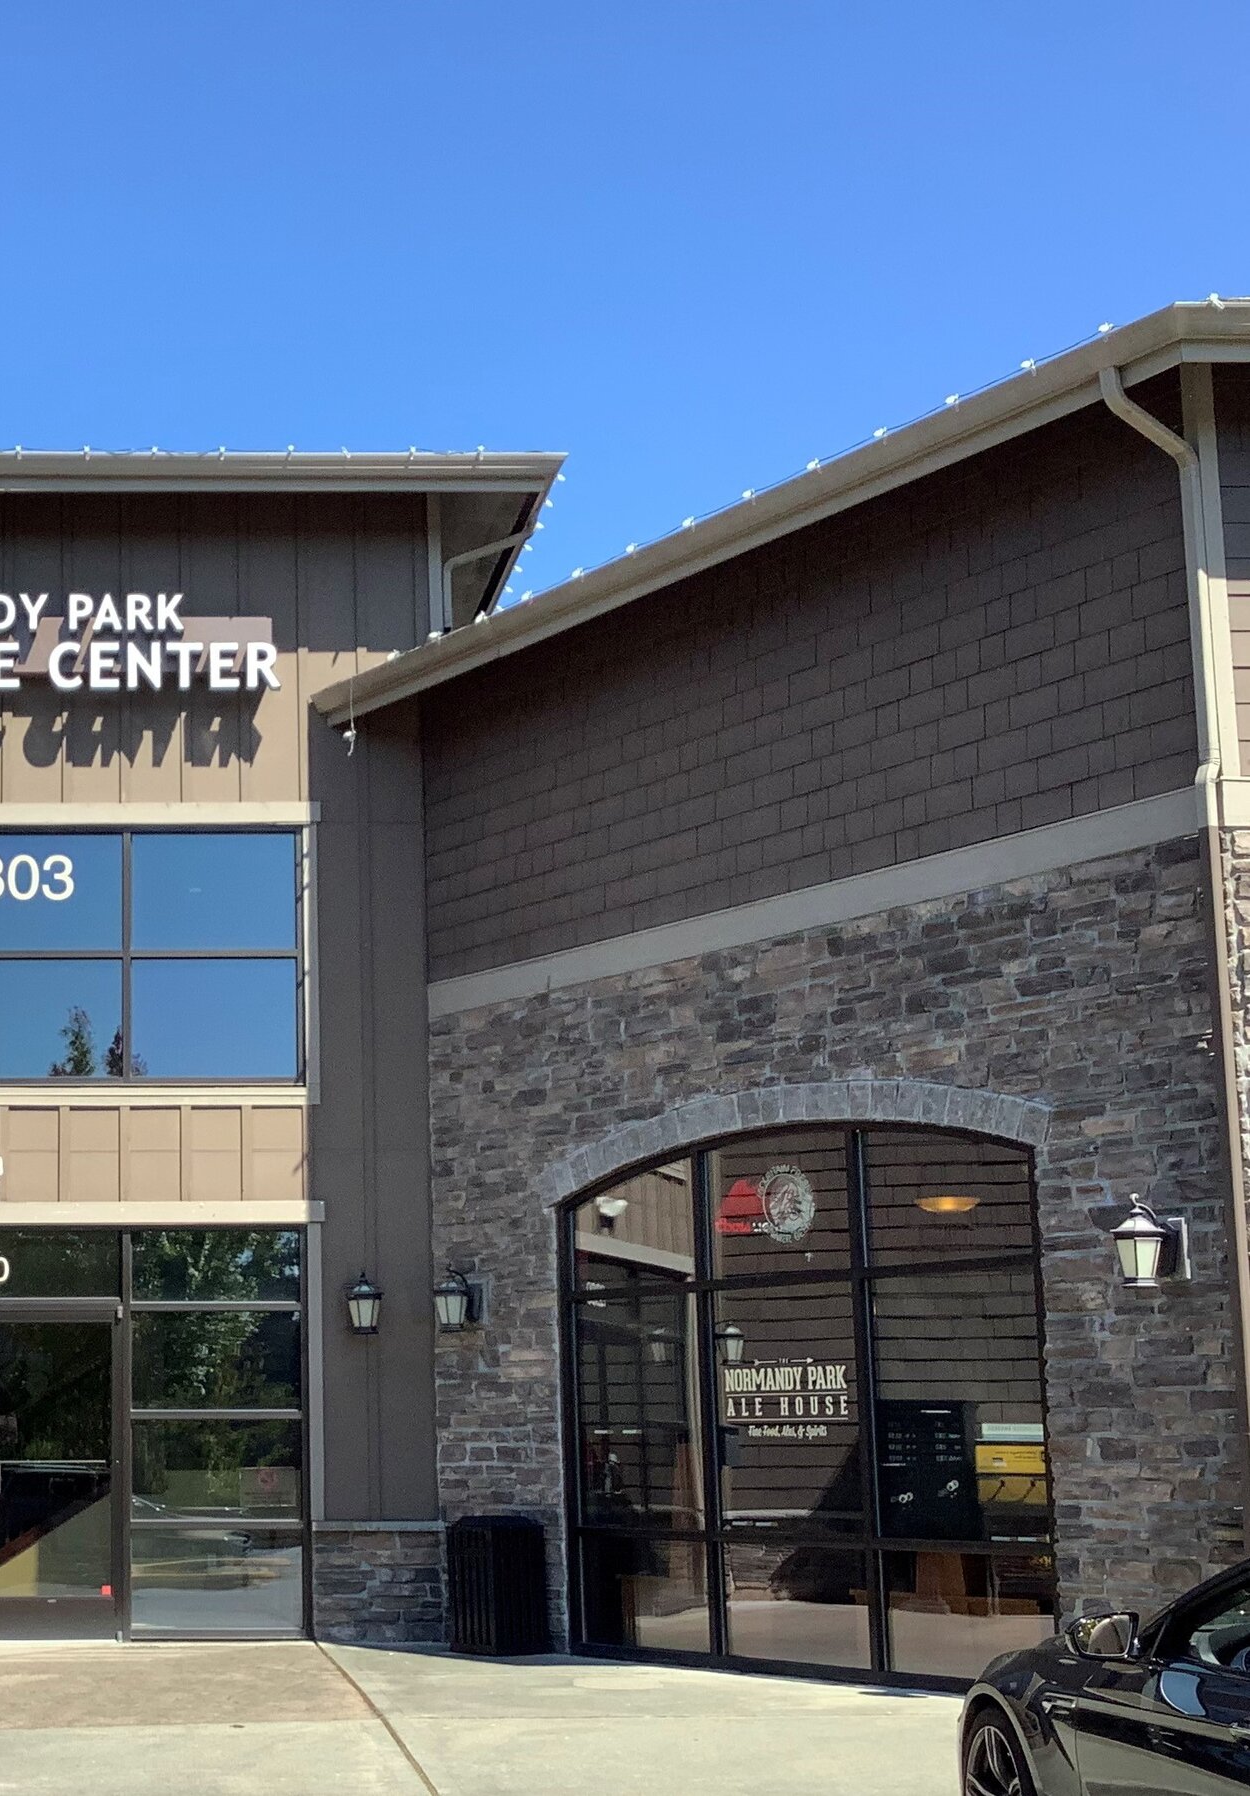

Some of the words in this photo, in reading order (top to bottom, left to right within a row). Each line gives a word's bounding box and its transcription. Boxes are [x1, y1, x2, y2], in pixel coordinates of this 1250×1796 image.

[68, 593, 185, 632] PARK
[48, 641, 282, 690] CENTER
[724, 1366, 803, 1392] NORMANDY
[806, 1364, 848, 1390] PARK
[726, 1398, 763, 1417] ALE
[780, 1395, 849, 1416] HOUSE
